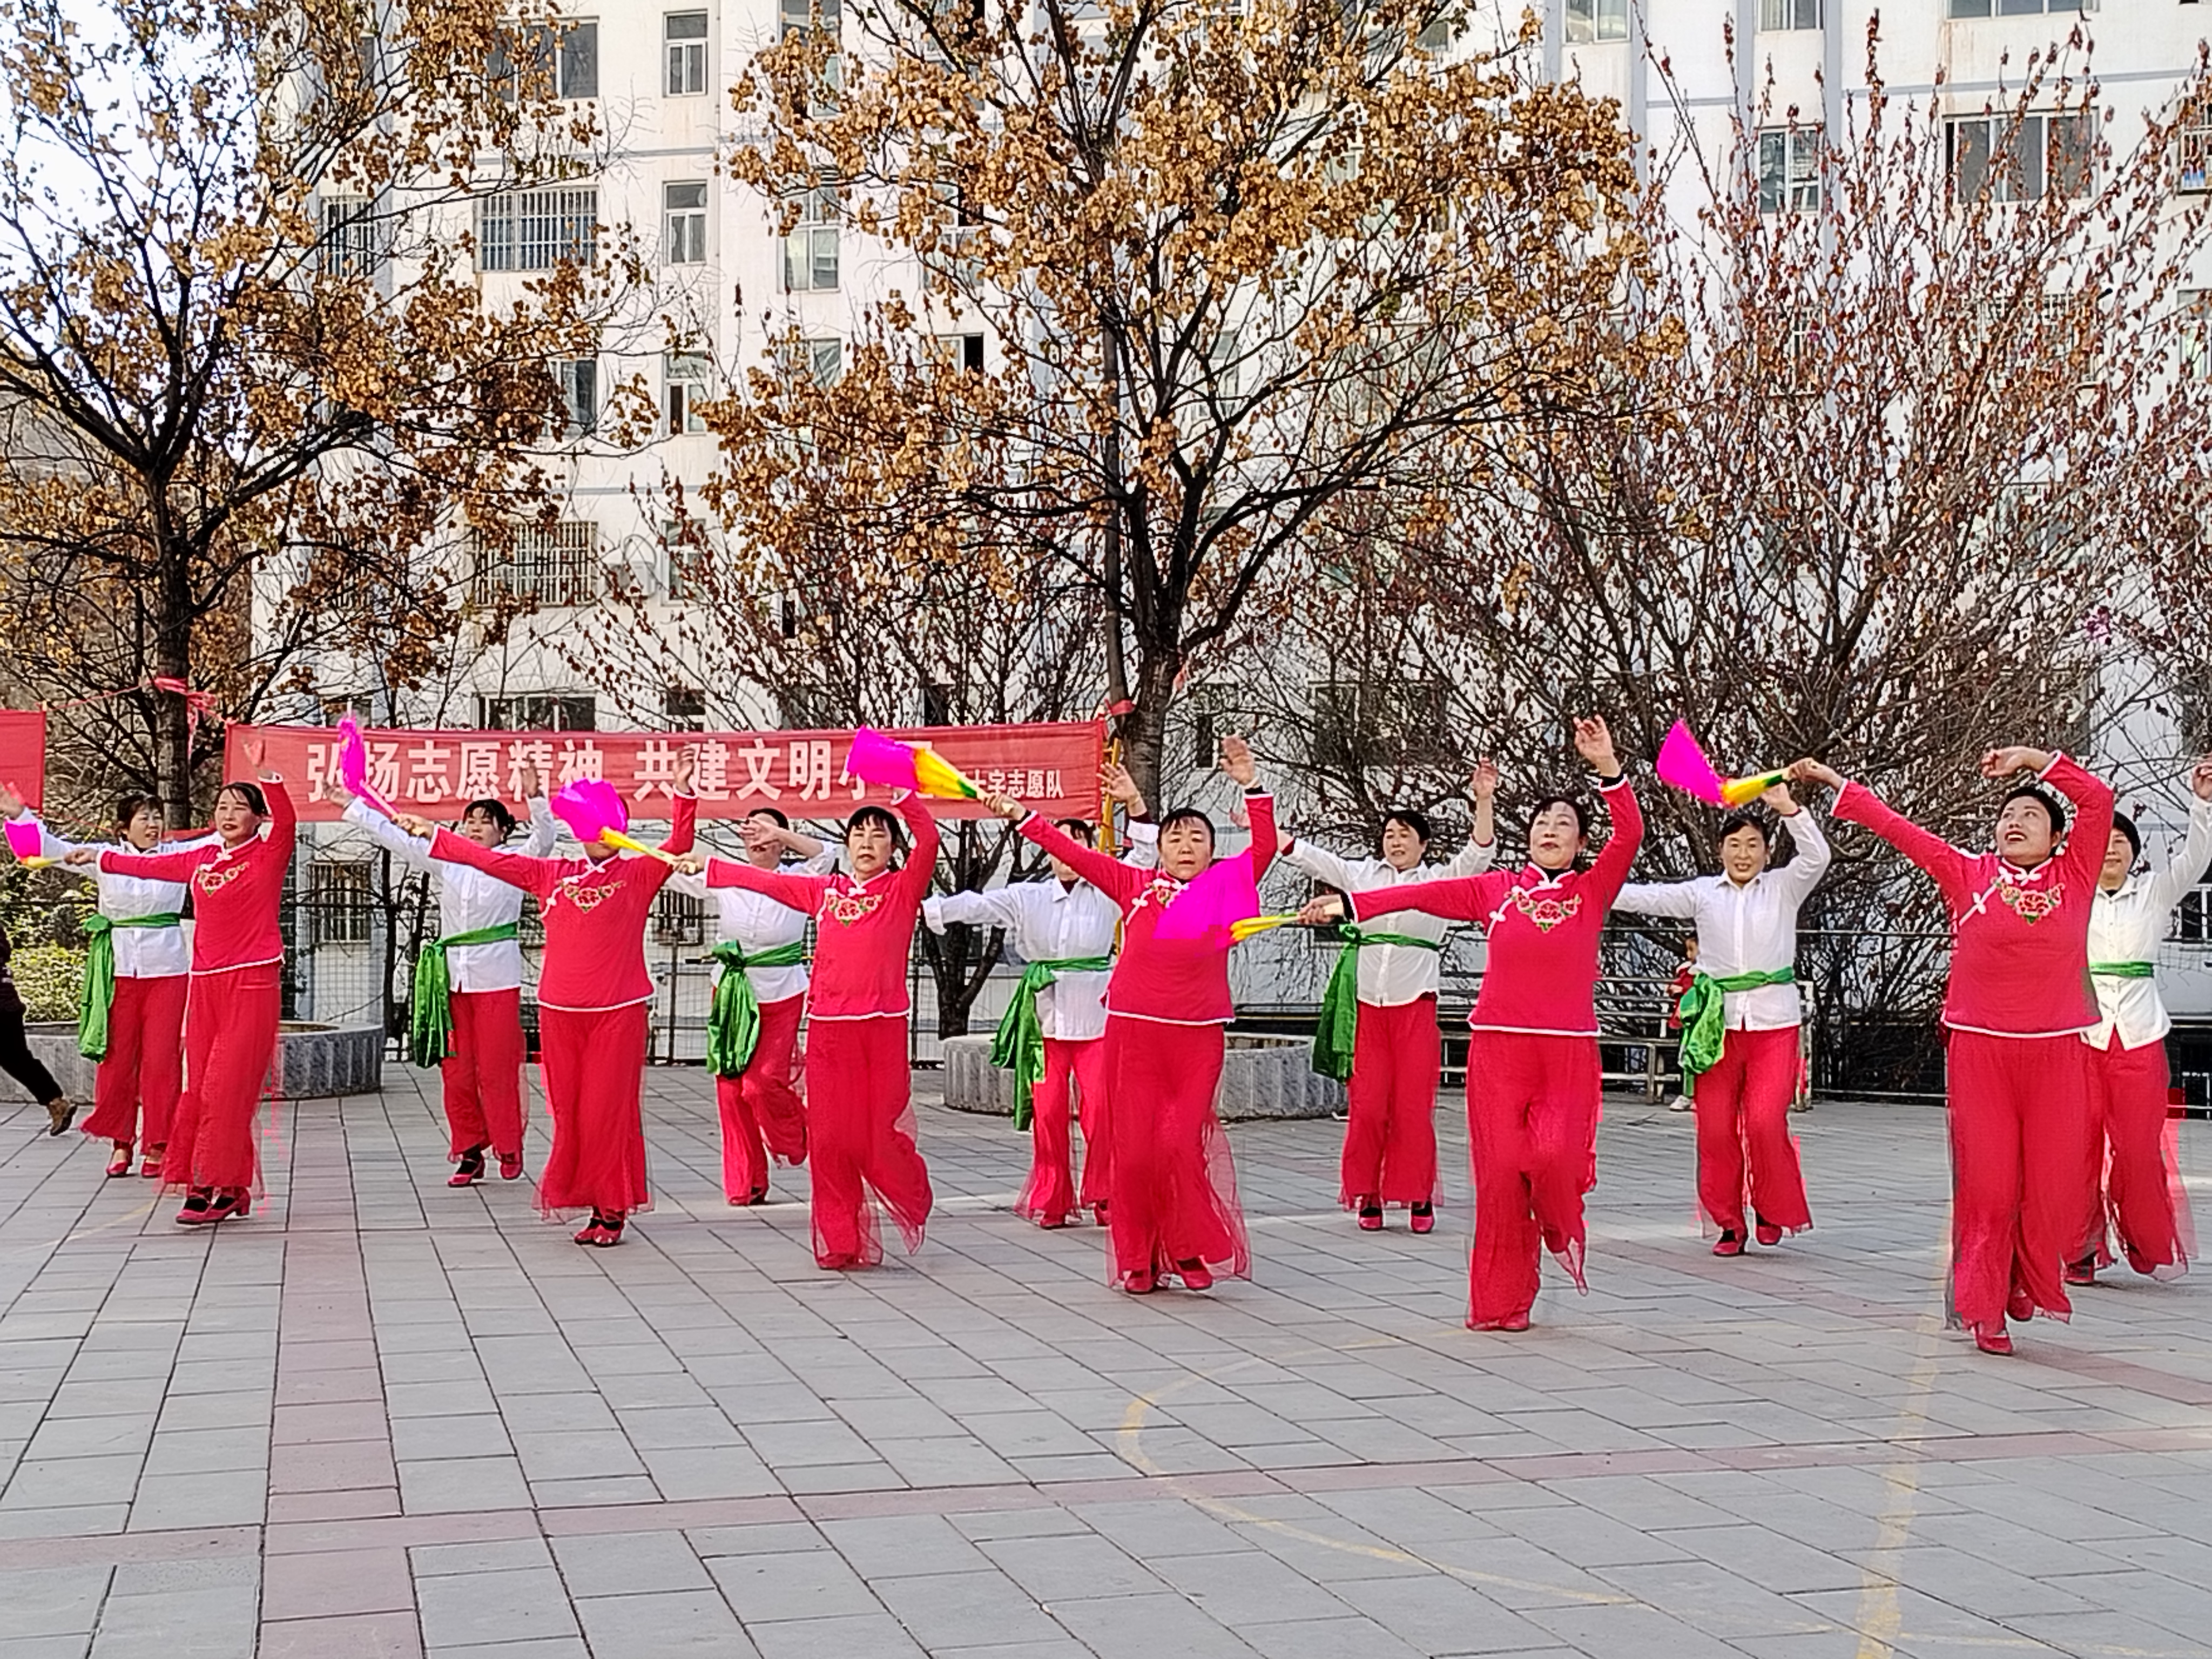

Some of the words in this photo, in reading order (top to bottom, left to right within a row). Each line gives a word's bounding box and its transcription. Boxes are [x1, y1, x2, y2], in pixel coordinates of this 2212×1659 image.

[307, 738, 603, 804] 弘扬志愿精神
[633, 738, 934, 801] 共建文明
[961, 769, 1064, 799] 十字志愿队
